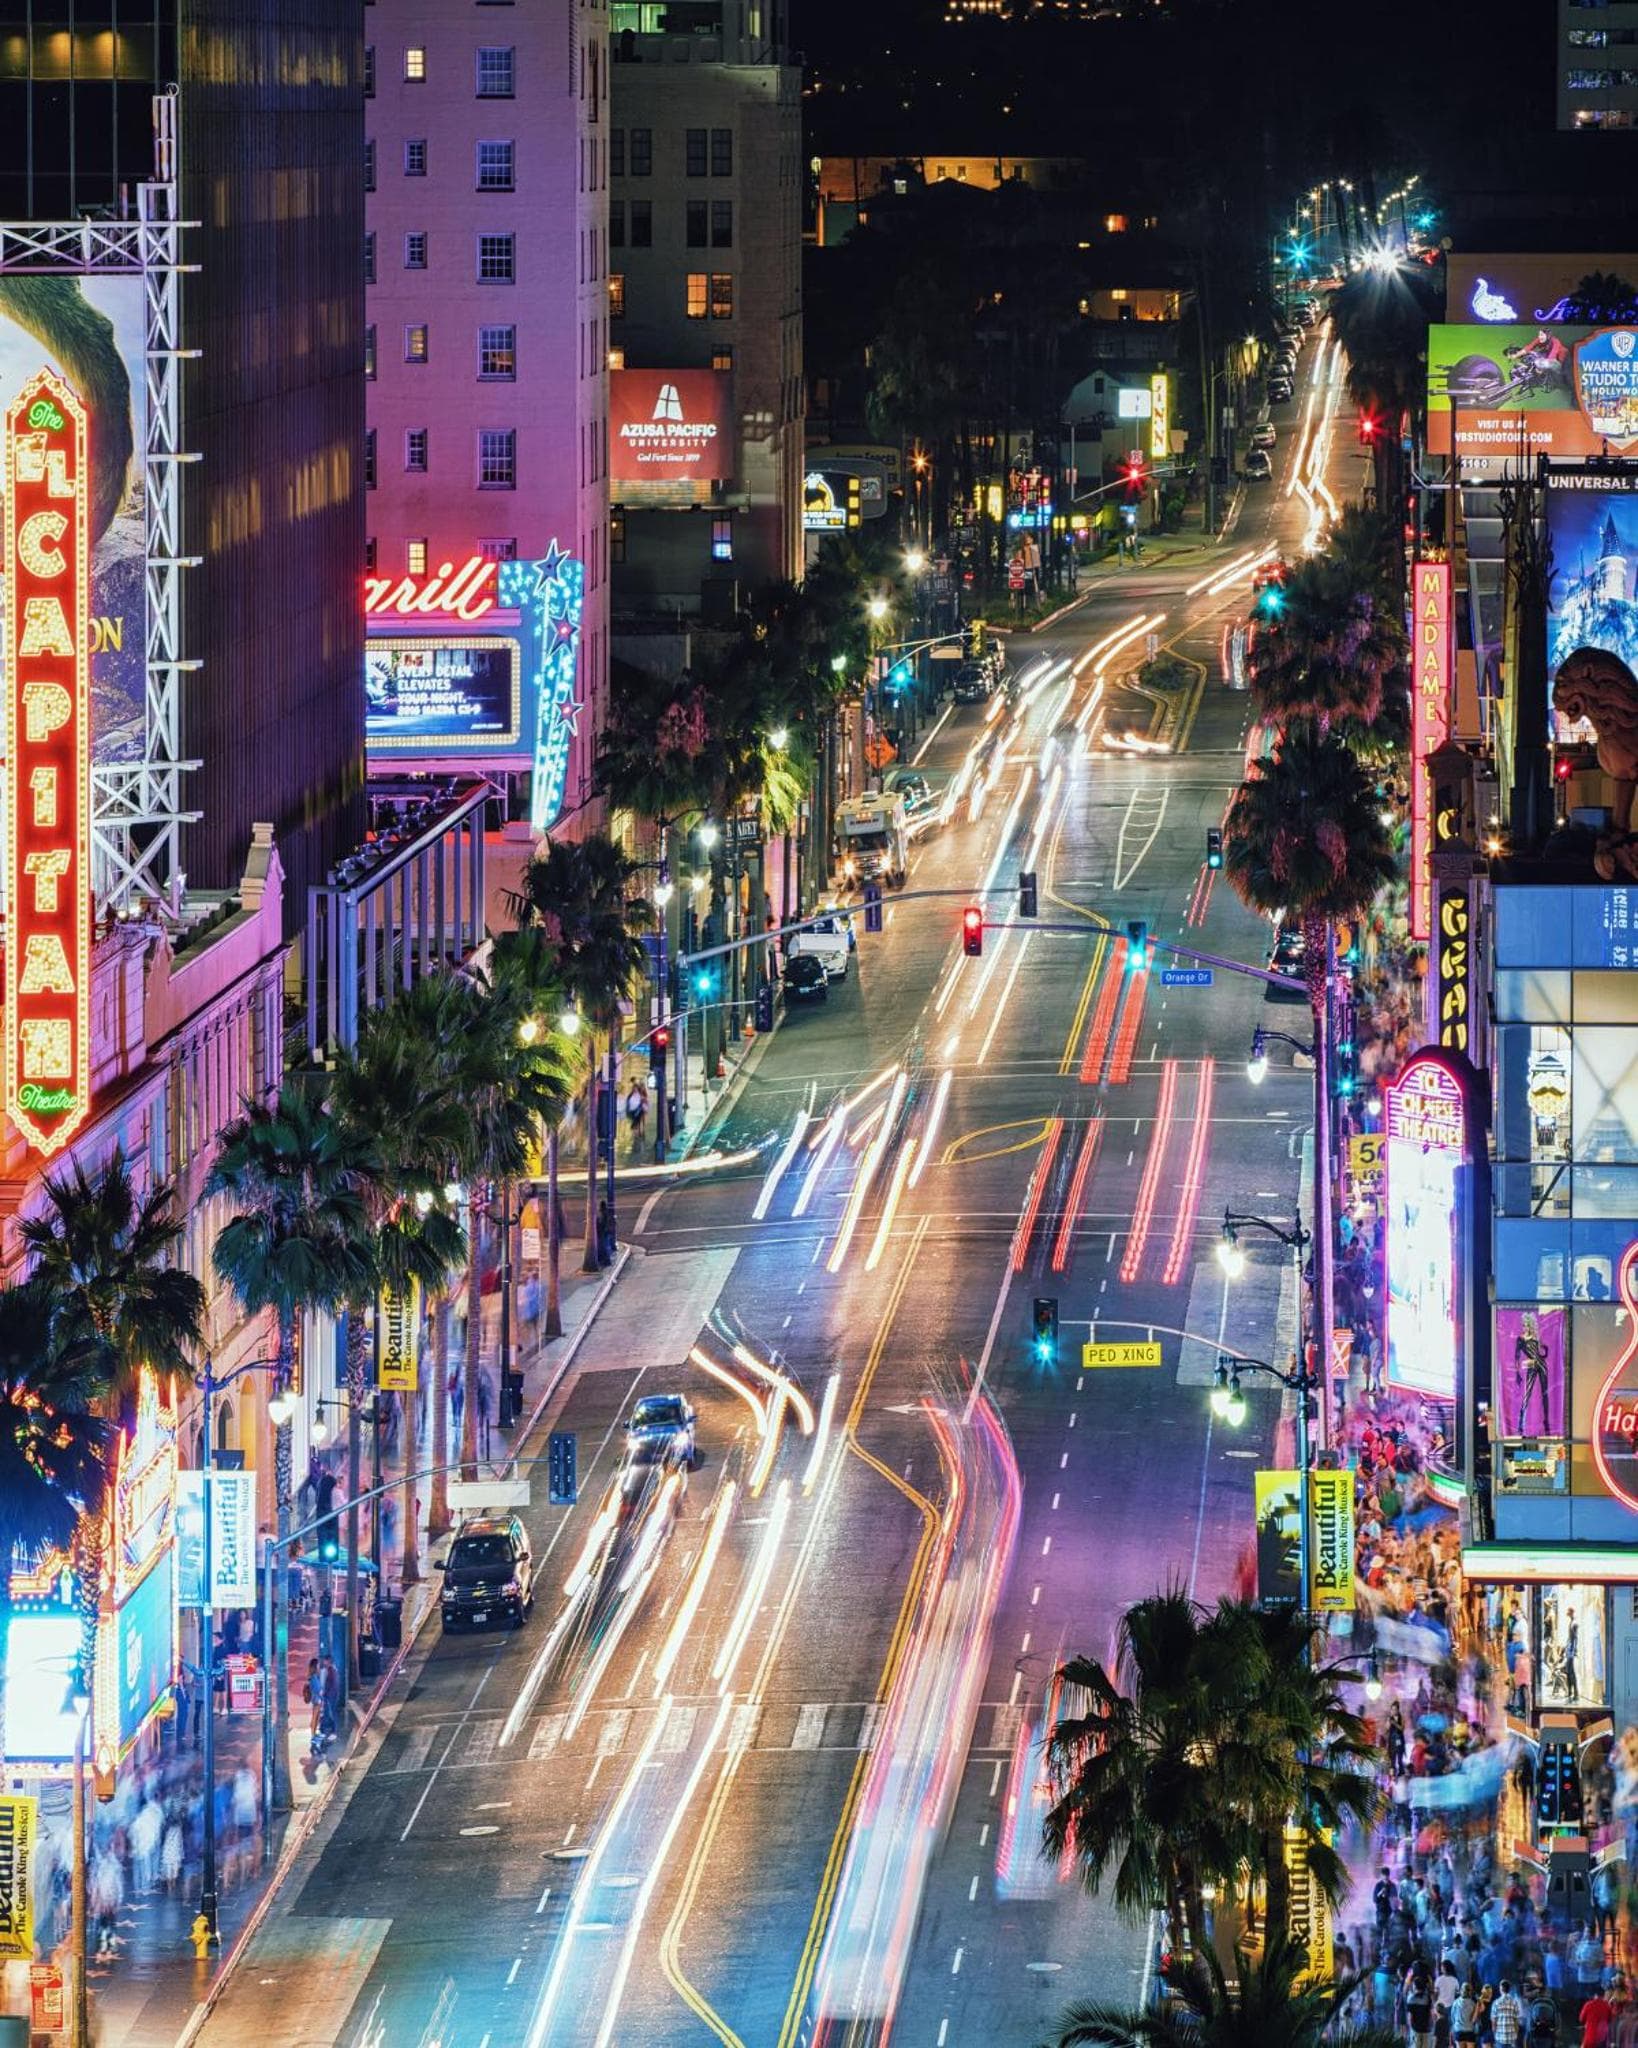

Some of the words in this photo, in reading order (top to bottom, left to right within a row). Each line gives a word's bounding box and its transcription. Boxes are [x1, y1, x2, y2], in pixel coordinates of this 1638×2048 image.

[1582, 361, 1630, 372] WARNER
[1581, 373, 1627, 386] STUDIO
[1630, 373, 1638, 386] T
[1591, 387, 1638, 395] HOLLYWO
[29, 400, 64, 430] The
[1477, 420, 1500, 429] VISIT
[1502, 420, 1514, 429] US
[620, 424, 666, 437] AZUSA
[667, 424, 717, 437] PACIFIC
[629, 439, 708, 447] UNIVERSITY
[16, 432, 76, 498] EL
[652, 453, 668, 462] First
[1549, 476, 1630, 489] UNIVERSAL
[1422, 571, 1441, 721] MADAME
[436, 665, 475, 678] DETAIL
[397, 678, 452, 691] ELEVATES
[397, 692, 429, 704] YOUR
[18, 511, 76, 1078] CAPITAN
[1166, 973, 1195, 984] Orange
[1198, 973, 1209, 982] Dr
[17, 1083, 80, 1110] Theatre
[1089, 1349, 1116, 1362] PED
[1122, 1347, 1155, 1361] XING
[1339, 1479, 1348, 1515] Musical
[216, 1478, 238, 1586] Beautiful
[1314, 1480, 1337, 1589] Beautiful
[1339, 1516, 1349, 1538] King
[1339, 1540, 1348, 1571] Carole
[1339, 1572, 1348, 1589] The
[18, 1806, 29, 1848] Musical
[17, 1849, 29, 1875] King
[16, 1875, 27, 1912] Carole
[15, 1914, 26, 1934] The
[1314, 1908, 1325, 1947] Carole
[1314, 1949, 1325, 1970] The
